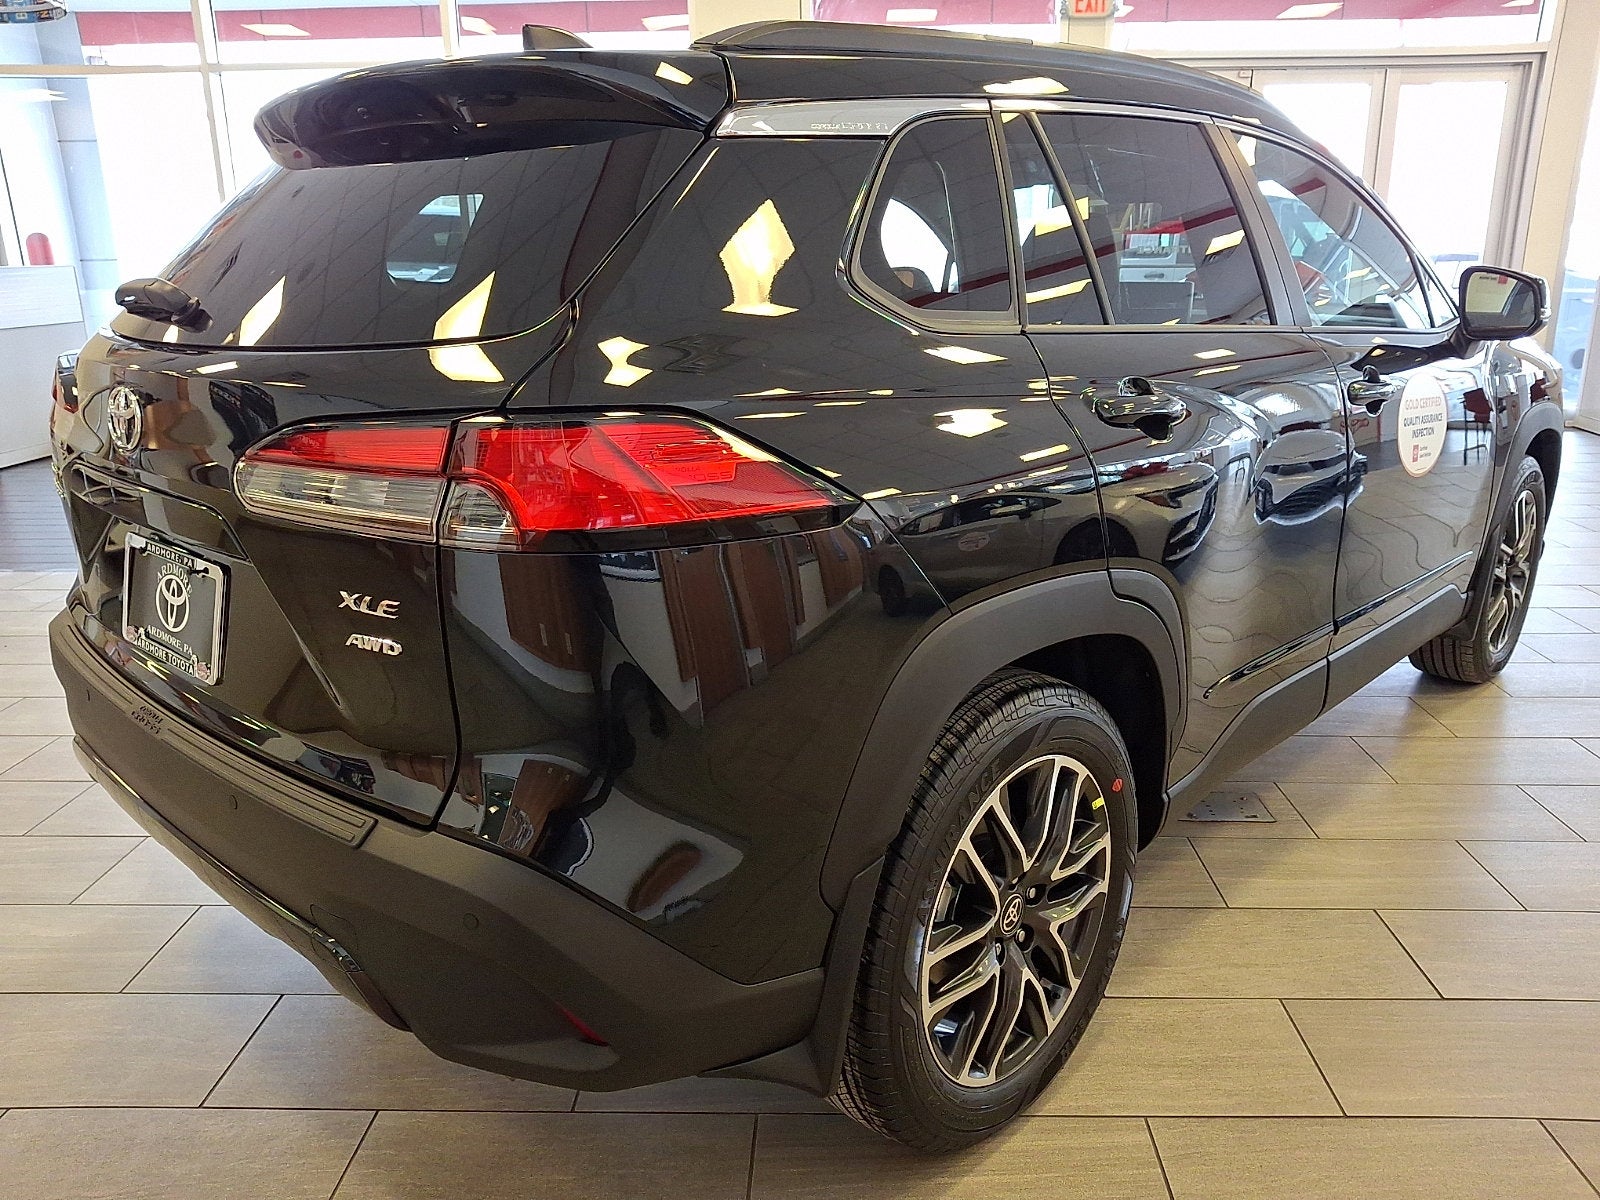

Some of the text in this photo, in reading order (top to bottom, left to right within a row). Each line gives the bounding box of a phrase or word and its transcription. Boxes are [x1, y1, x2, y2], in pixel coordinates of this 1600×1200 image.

[1075, 0, 1105, 13] EXIT
[1406, 397, 1441, 410] GOLD CERTIFIED
[1404, 413, 1442, 427] QUALITY ASSURANCE
[1412, 427, 1434, 438] INSPECTION
[146, 543, 194, 567] ARDMORE, PA
[157, 562, 194, 597] ARDMORE
[338, 590, 401, 620] XLE
[146, 624, 194, 656] ARDMORE, PA
[345, 633, 403, 656] AWD
[137, 638, 195, 676] ARDMORE TOYOTA
